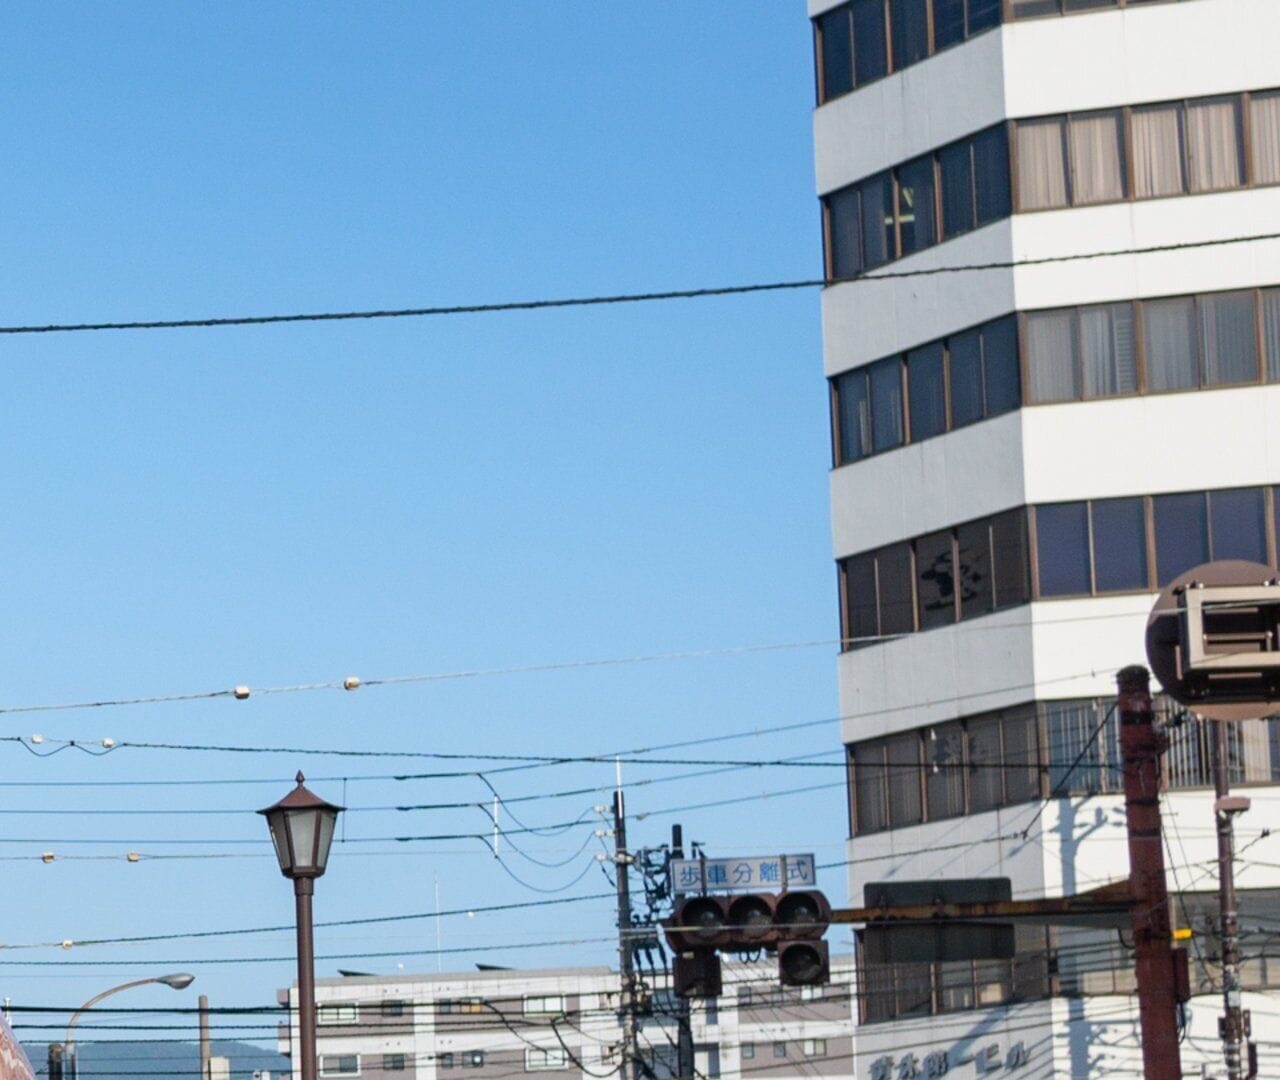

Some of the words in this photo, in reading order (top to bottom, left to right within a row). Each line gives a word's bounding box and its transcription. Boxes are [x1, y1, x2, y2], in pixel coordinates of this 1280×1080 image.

[680, 859, 808, 887] 歩車分離式
